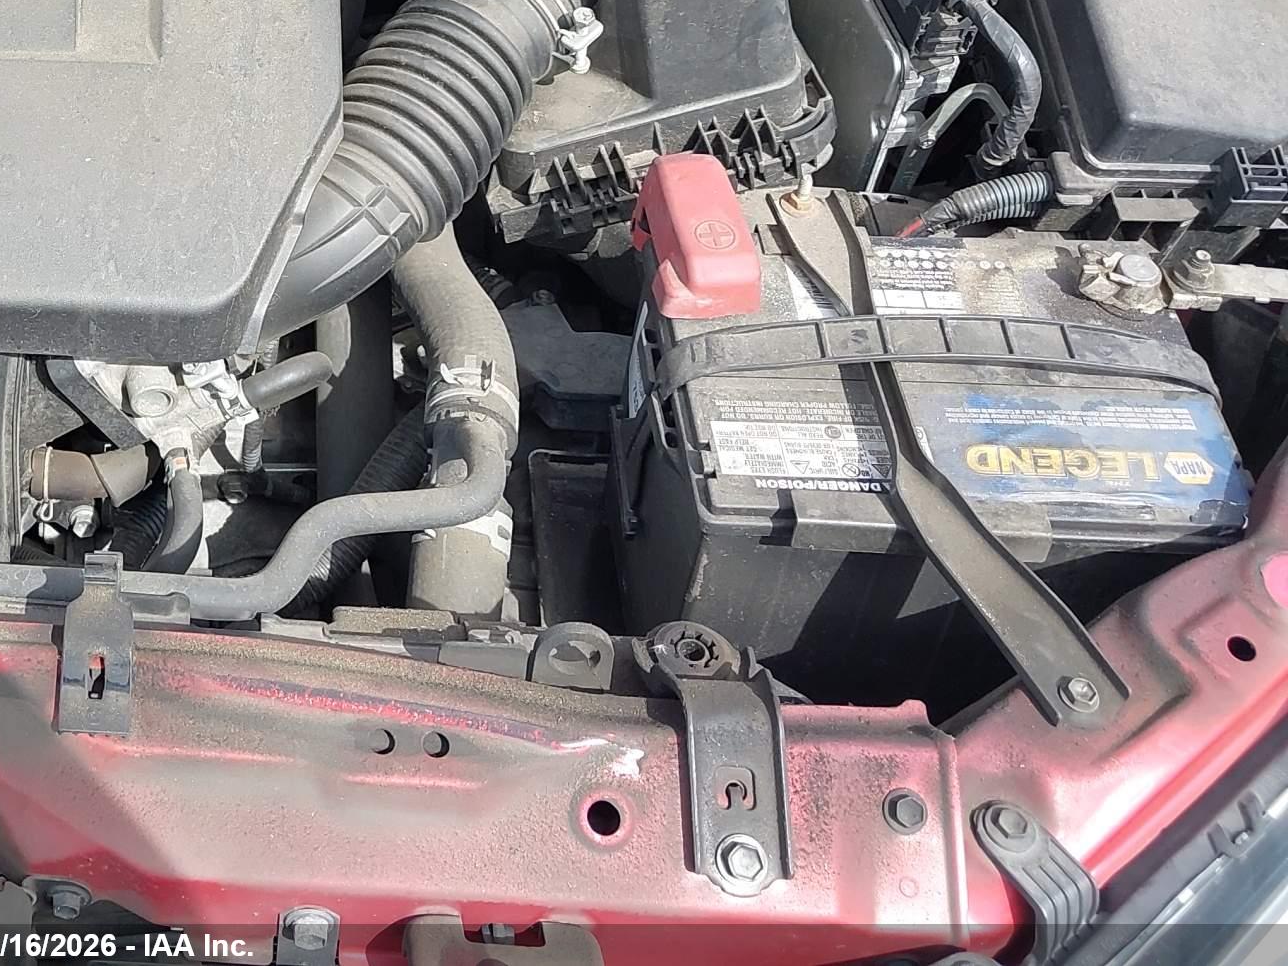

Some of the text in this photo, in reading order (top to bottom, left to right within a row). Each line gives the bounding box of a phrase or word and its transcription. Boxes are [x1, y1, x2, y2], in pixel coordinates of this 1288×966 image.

[964, 445, 1161, 482] LEGEND
[1168, 461, 1208, 475] NAPA
[755, 479, 882, 492] DANGER/POISON
